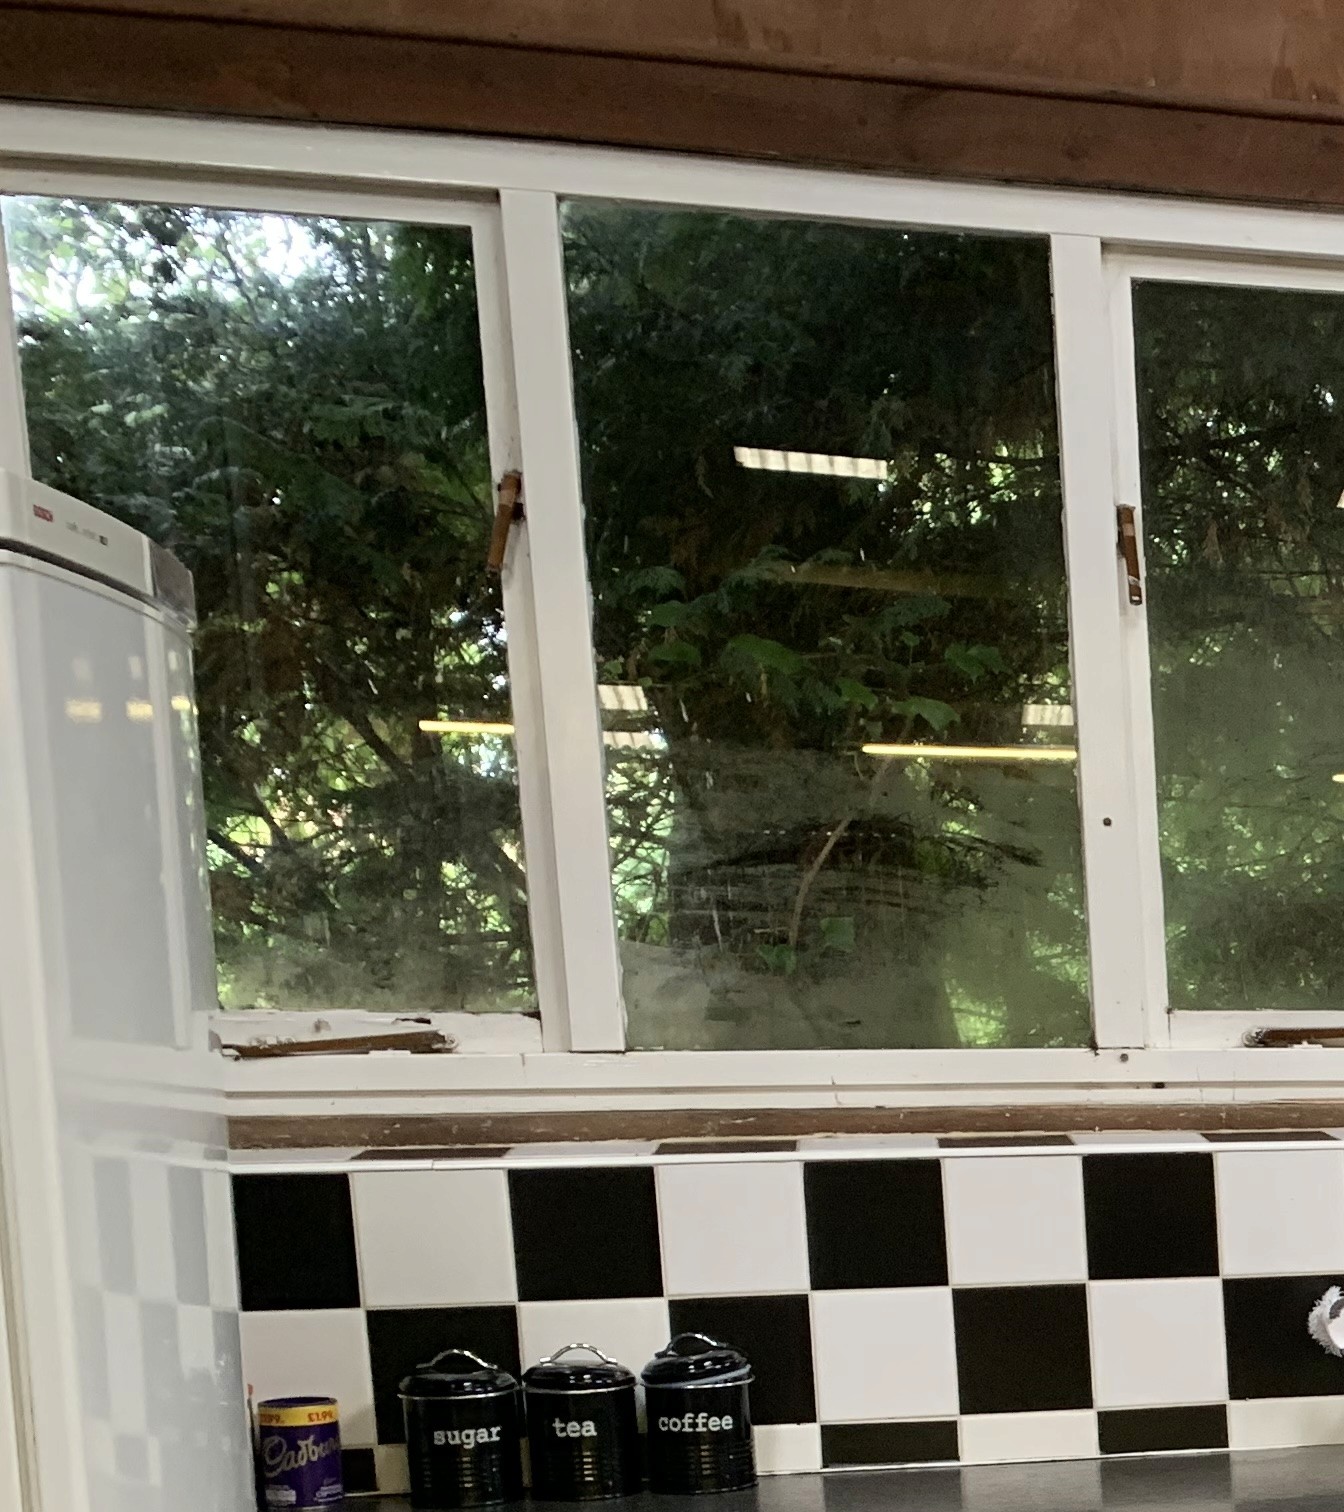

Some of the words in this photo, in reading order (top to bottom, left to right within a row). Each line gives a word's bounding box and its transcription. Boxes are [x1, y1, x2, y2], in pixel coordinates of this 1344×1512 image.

[552, 1417, 598, 1438] tea
[658, 1412, 734, 1433] coffee
[433, 1424, 502, 1449] sugar
